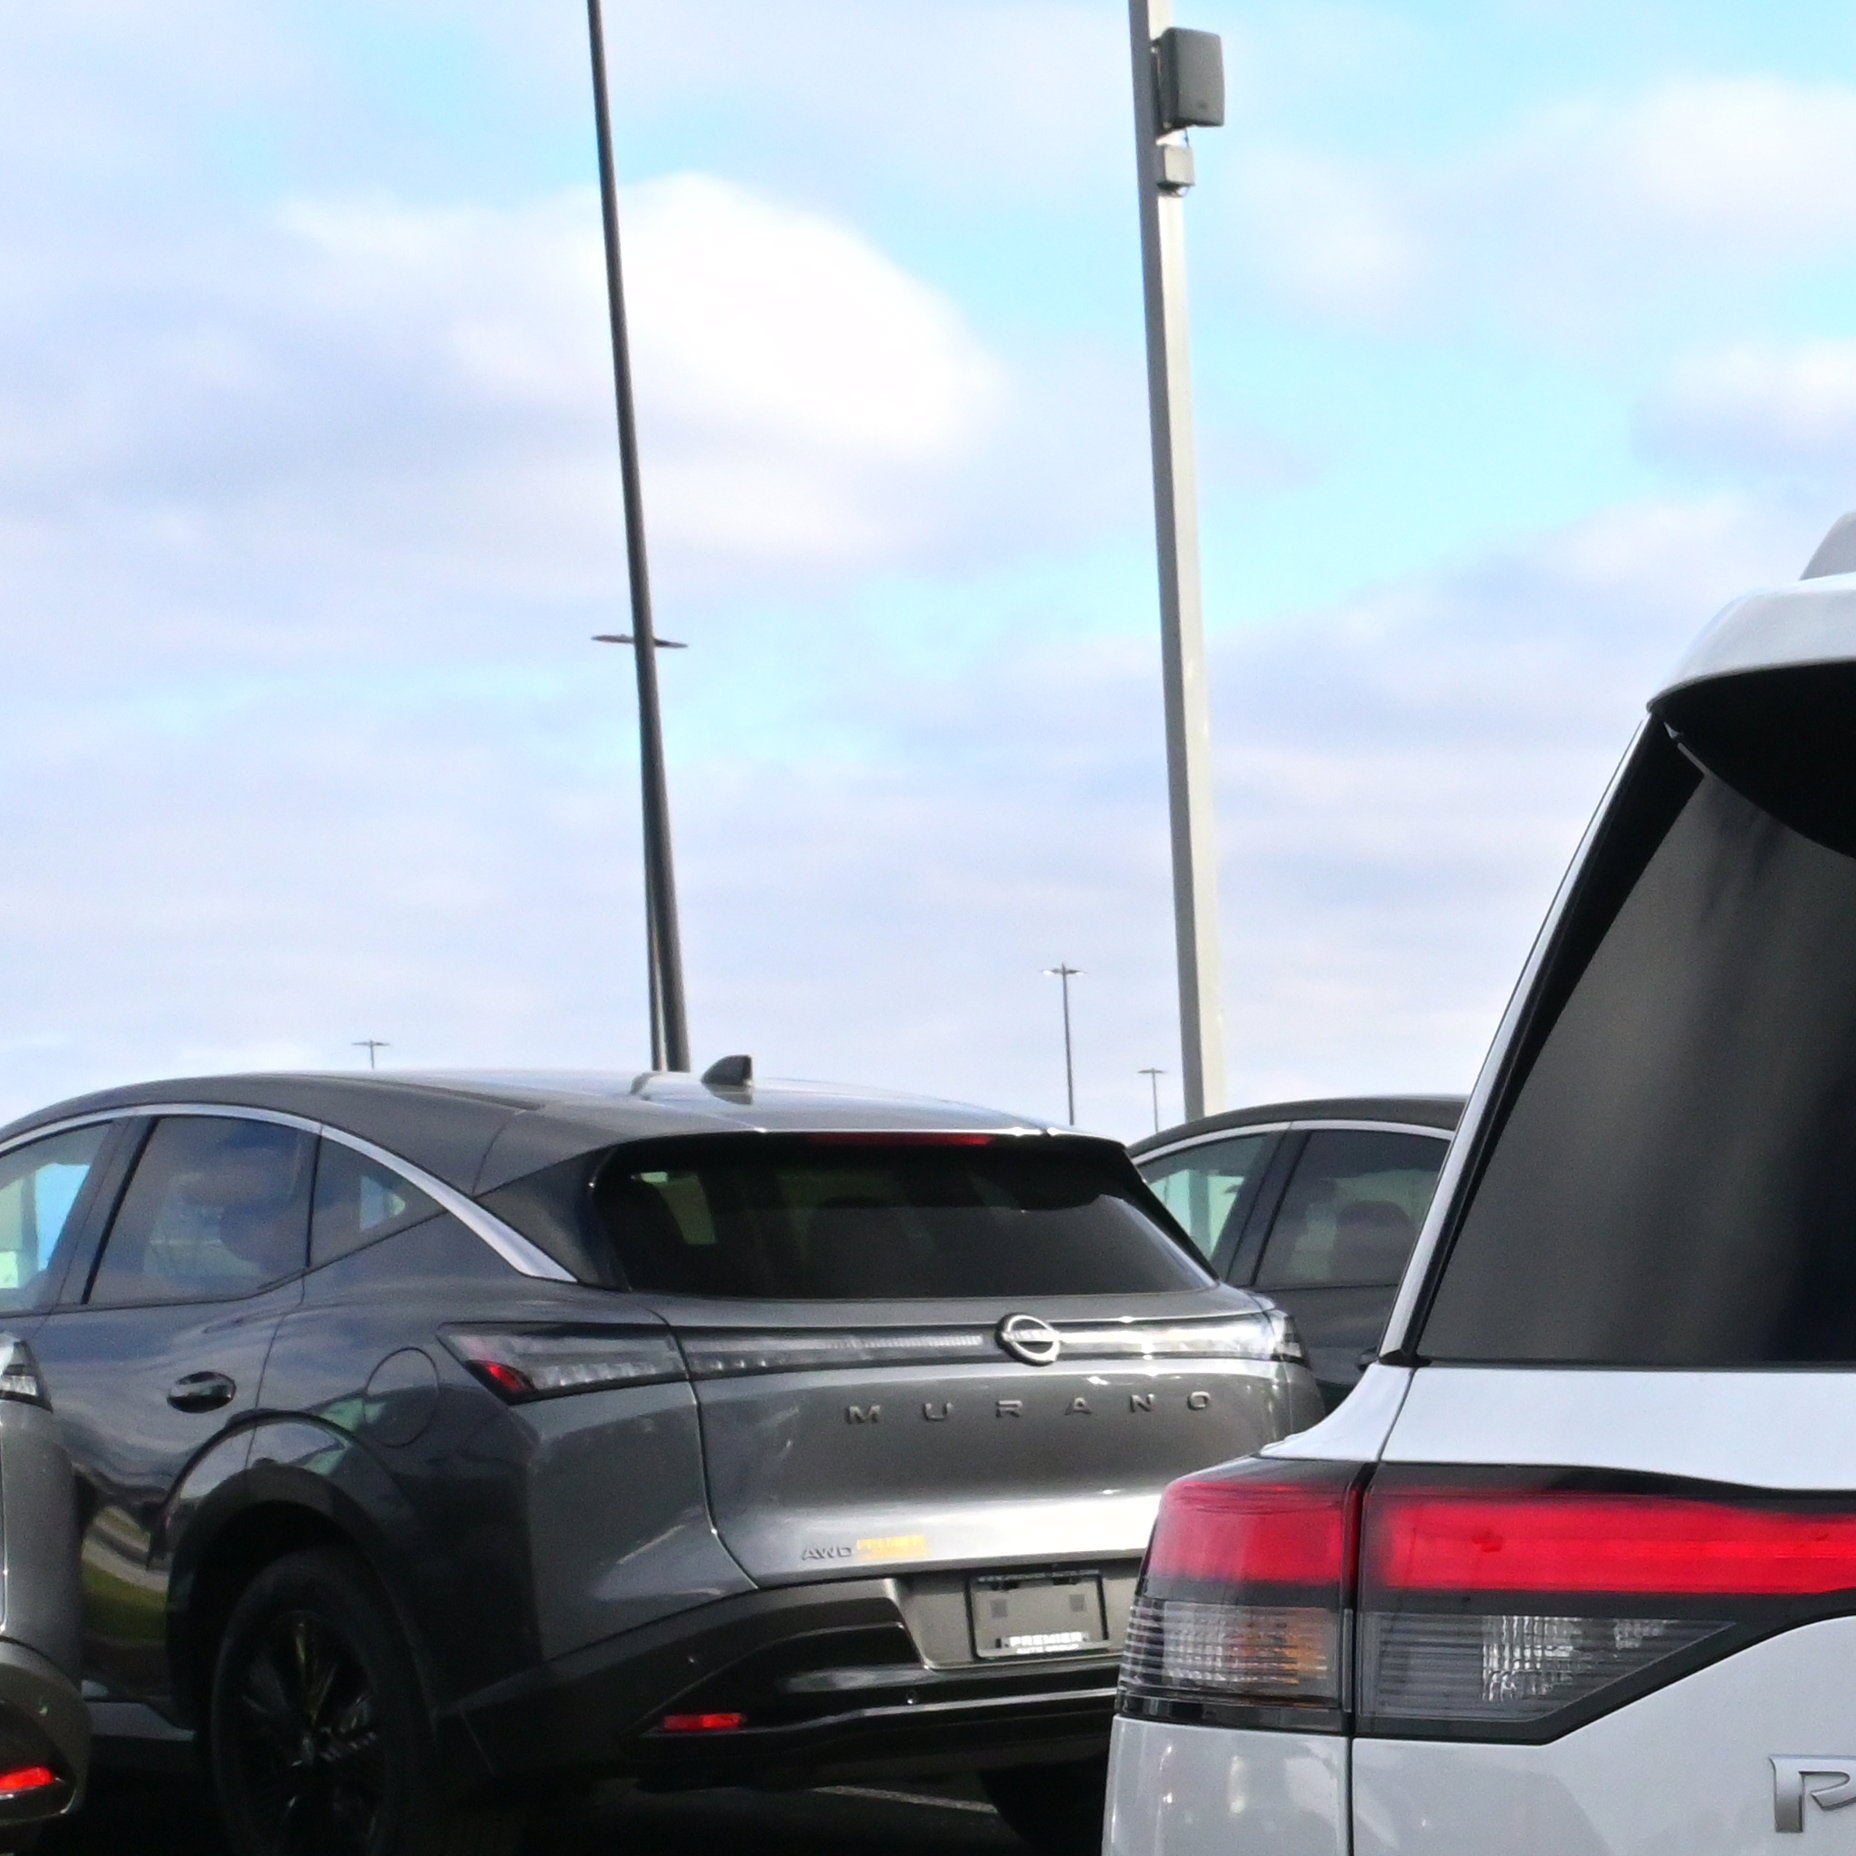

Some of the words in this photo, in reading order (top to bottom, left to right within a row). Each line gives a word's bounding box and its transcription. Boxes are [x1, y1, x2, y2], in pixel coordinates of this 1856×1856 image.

[846, 1391, 1212, 1424] MURANO
[802, 1546, 852, 1561] AWD
[1009, 1631, 1083, 1647] PREMIER
